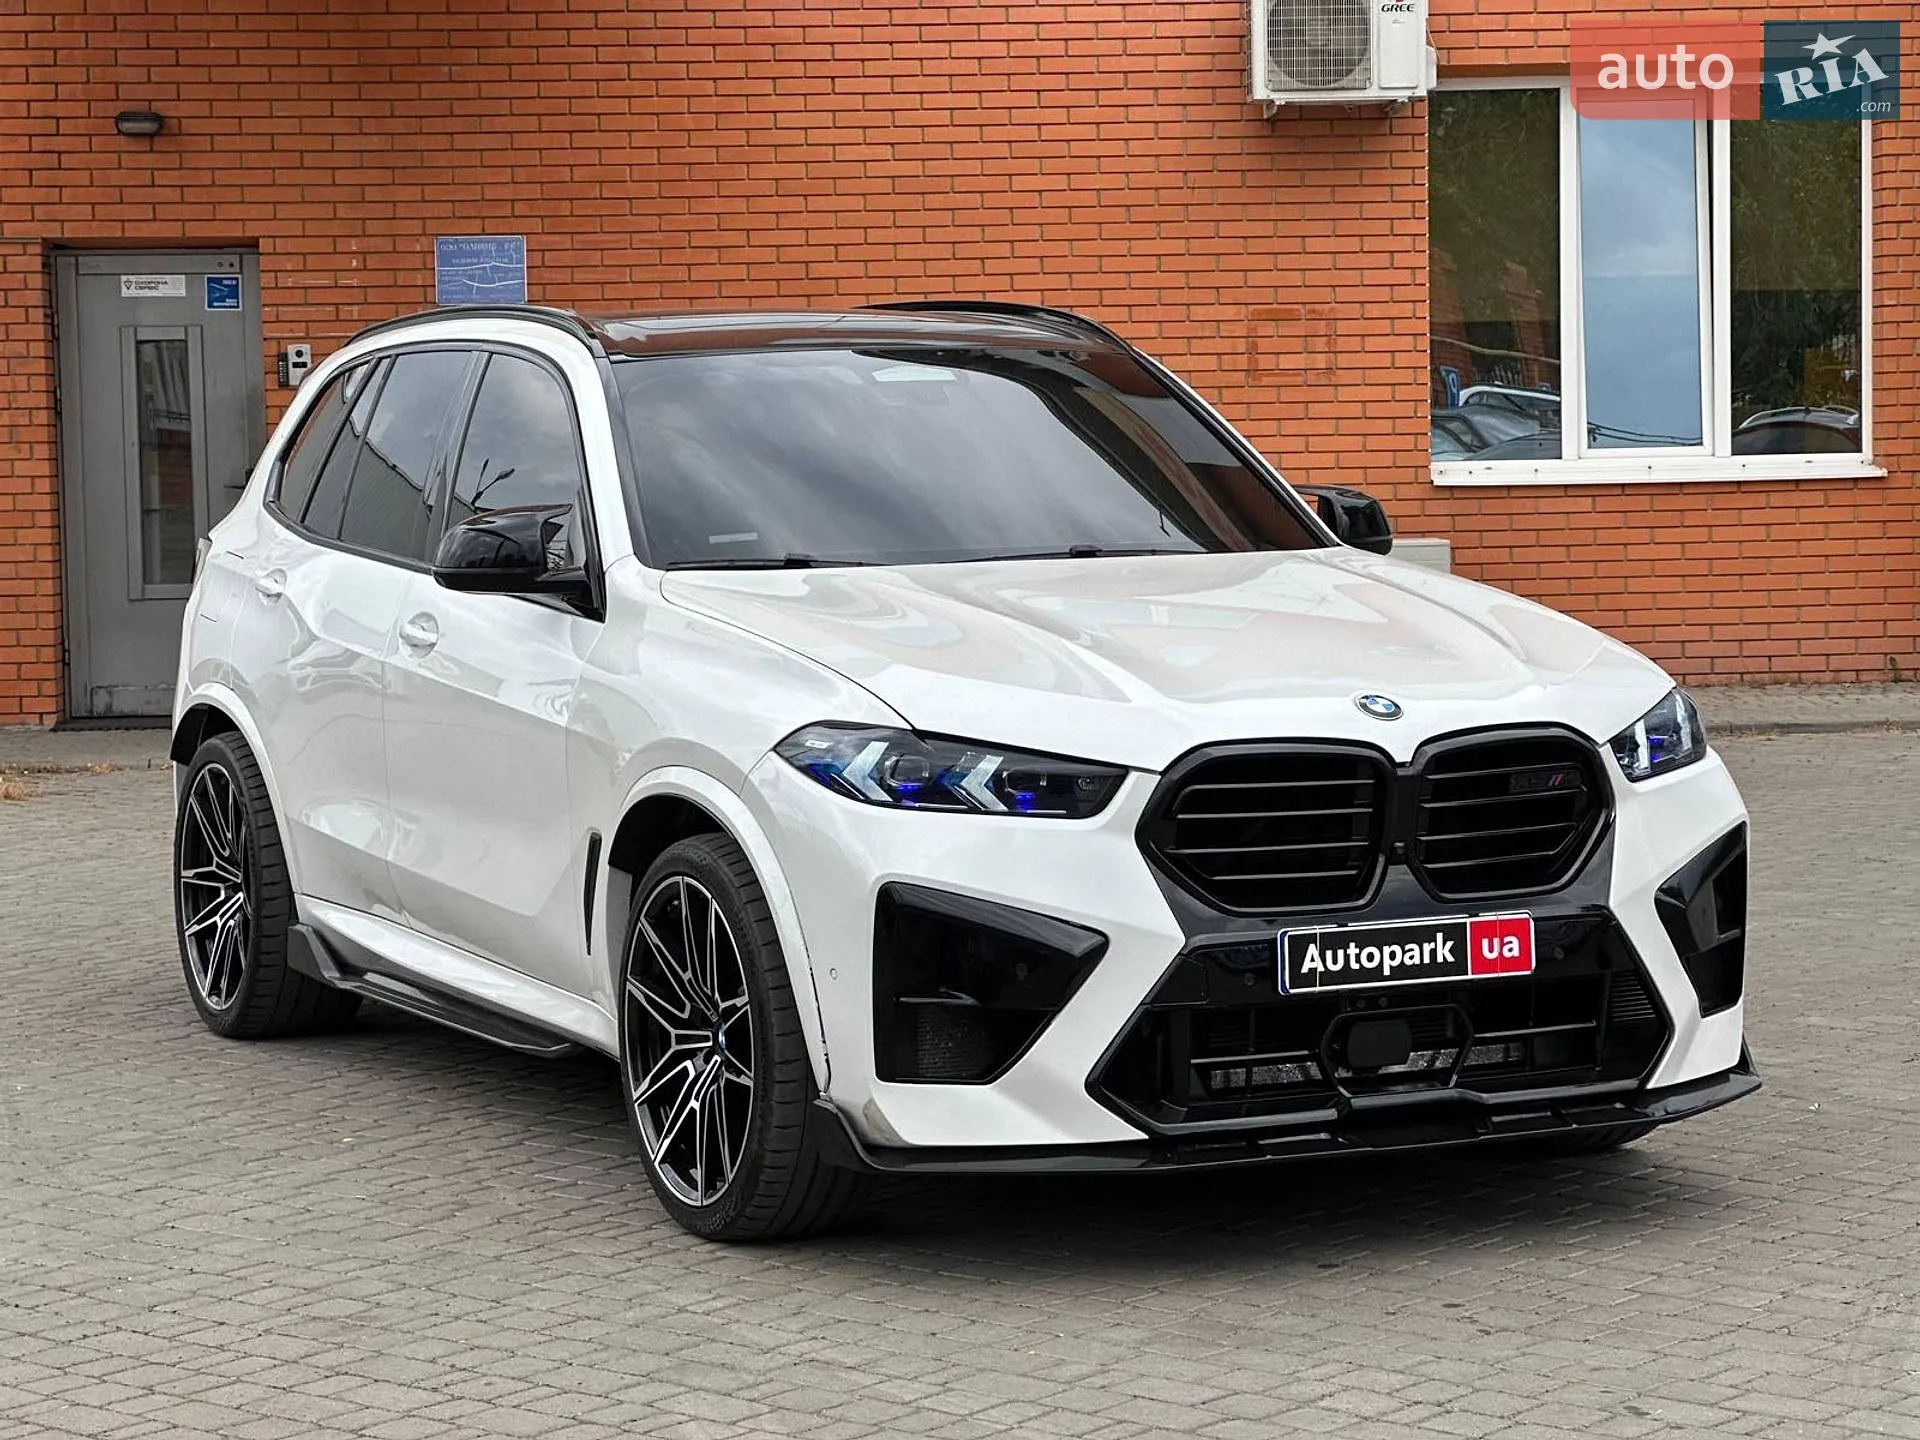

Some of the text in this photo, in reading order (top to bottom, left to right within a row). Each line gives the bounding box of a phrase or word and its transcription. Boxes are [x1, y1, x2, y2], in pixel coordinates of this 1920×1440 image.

[1381, 3, 1415, 12] GREE
[1301, 932, 1521, 976] Autopark ua
